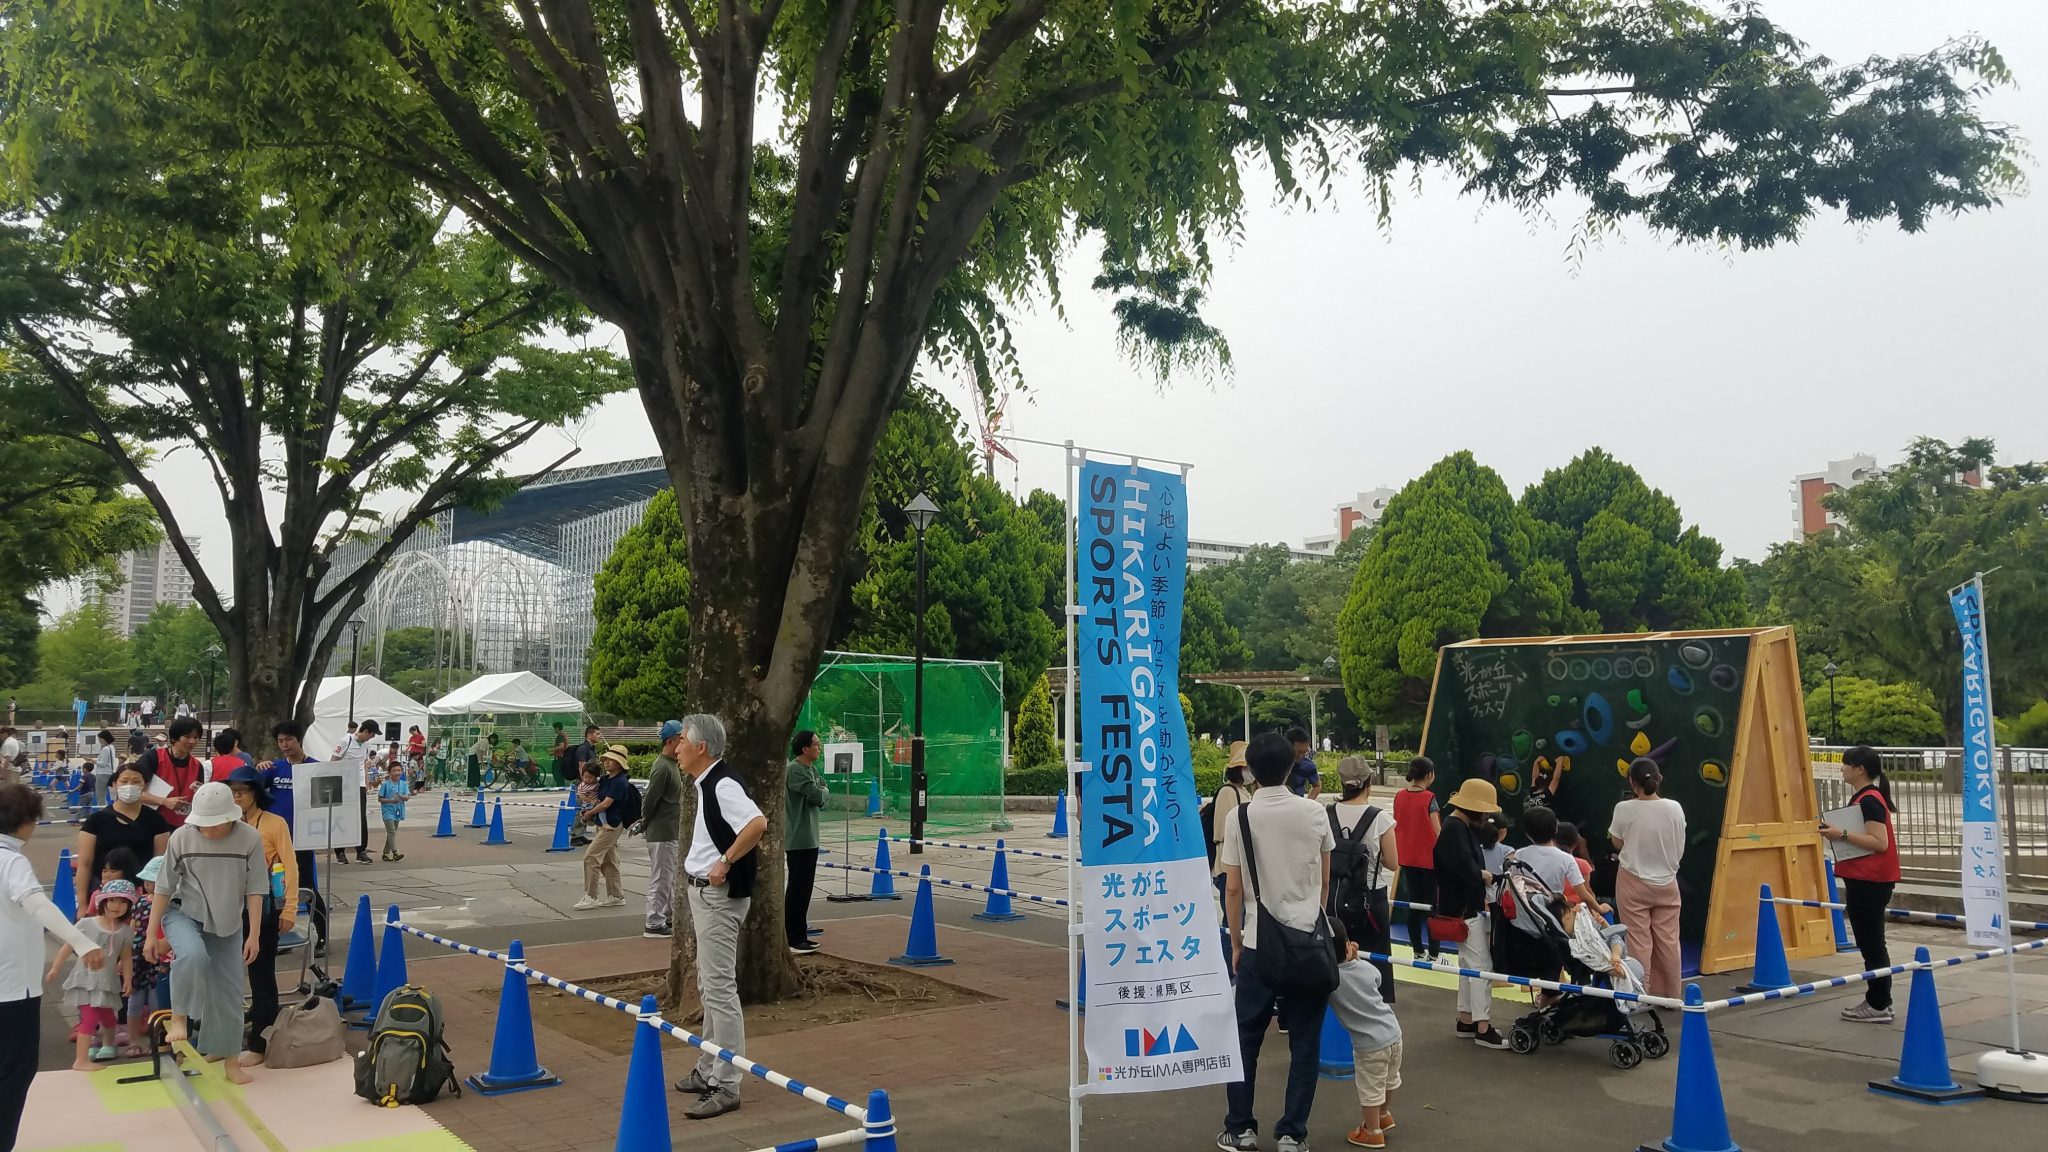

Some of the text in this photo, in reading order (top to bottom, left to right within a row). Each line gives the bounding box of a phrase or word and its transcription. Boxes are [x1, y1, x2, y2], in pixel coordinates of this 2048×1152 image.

[1089, 475, 1134, 849] SPORTS FESTA
[1122, 479, 1160, 847] HIKARIGAOKA
[1459, 661, 1513, 684] 光が丘
[1464, 680, 1512, 702] スポーツ
[1469, 700, 1506, 720] フェスタ
[1101, 870, 1168, 899] 光が丘
[1104, 902, 1196, 933] スポーツ
[1105, 935, 1201, 967] フェスタ
[1124, 1022, 1200, 1057] IMA
[1114, 1054, 1231, 1080] 光が丘IMA専門店街
